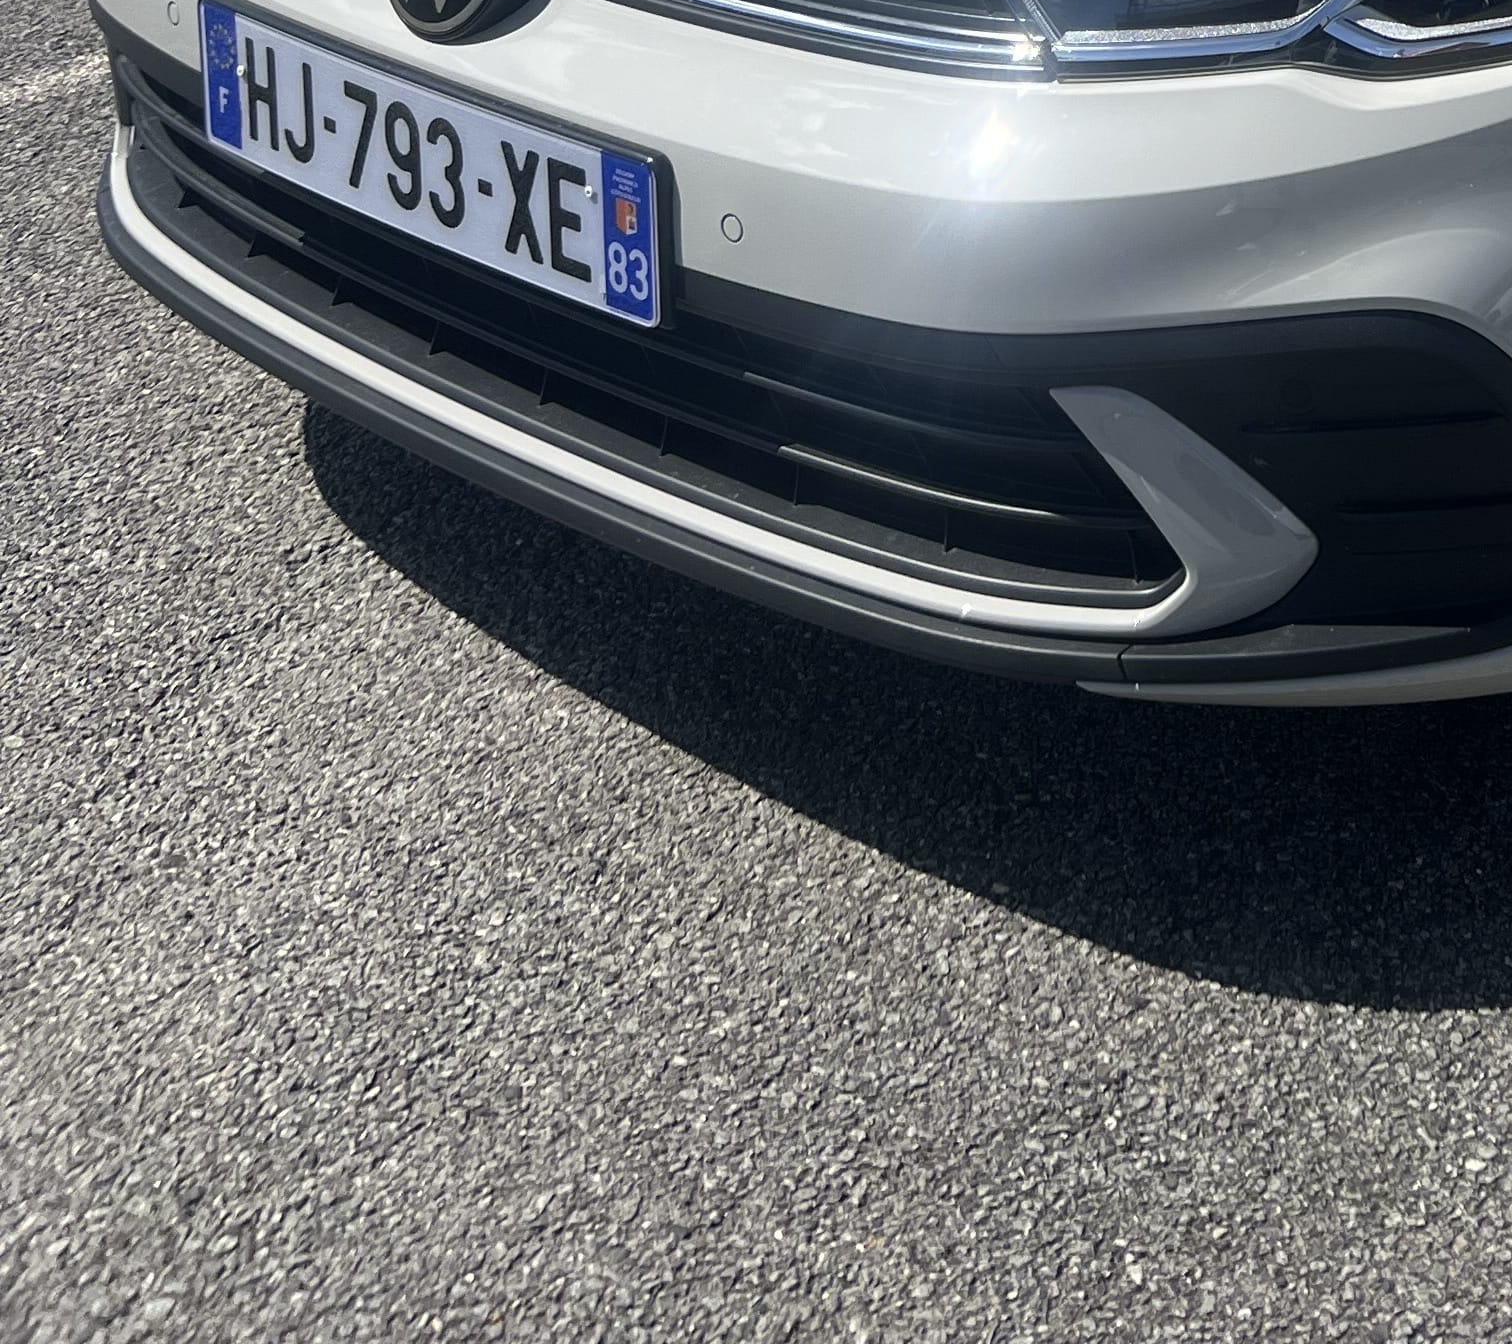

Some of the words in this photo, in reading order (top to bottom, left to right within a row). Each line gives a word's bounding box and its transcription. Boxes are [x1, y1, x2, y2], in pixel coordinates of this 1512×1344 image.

[218, 85, 230, 113] F
[245, 37, 593, 283] HJ-793-XE
[607, 241, 649, 301] 83
